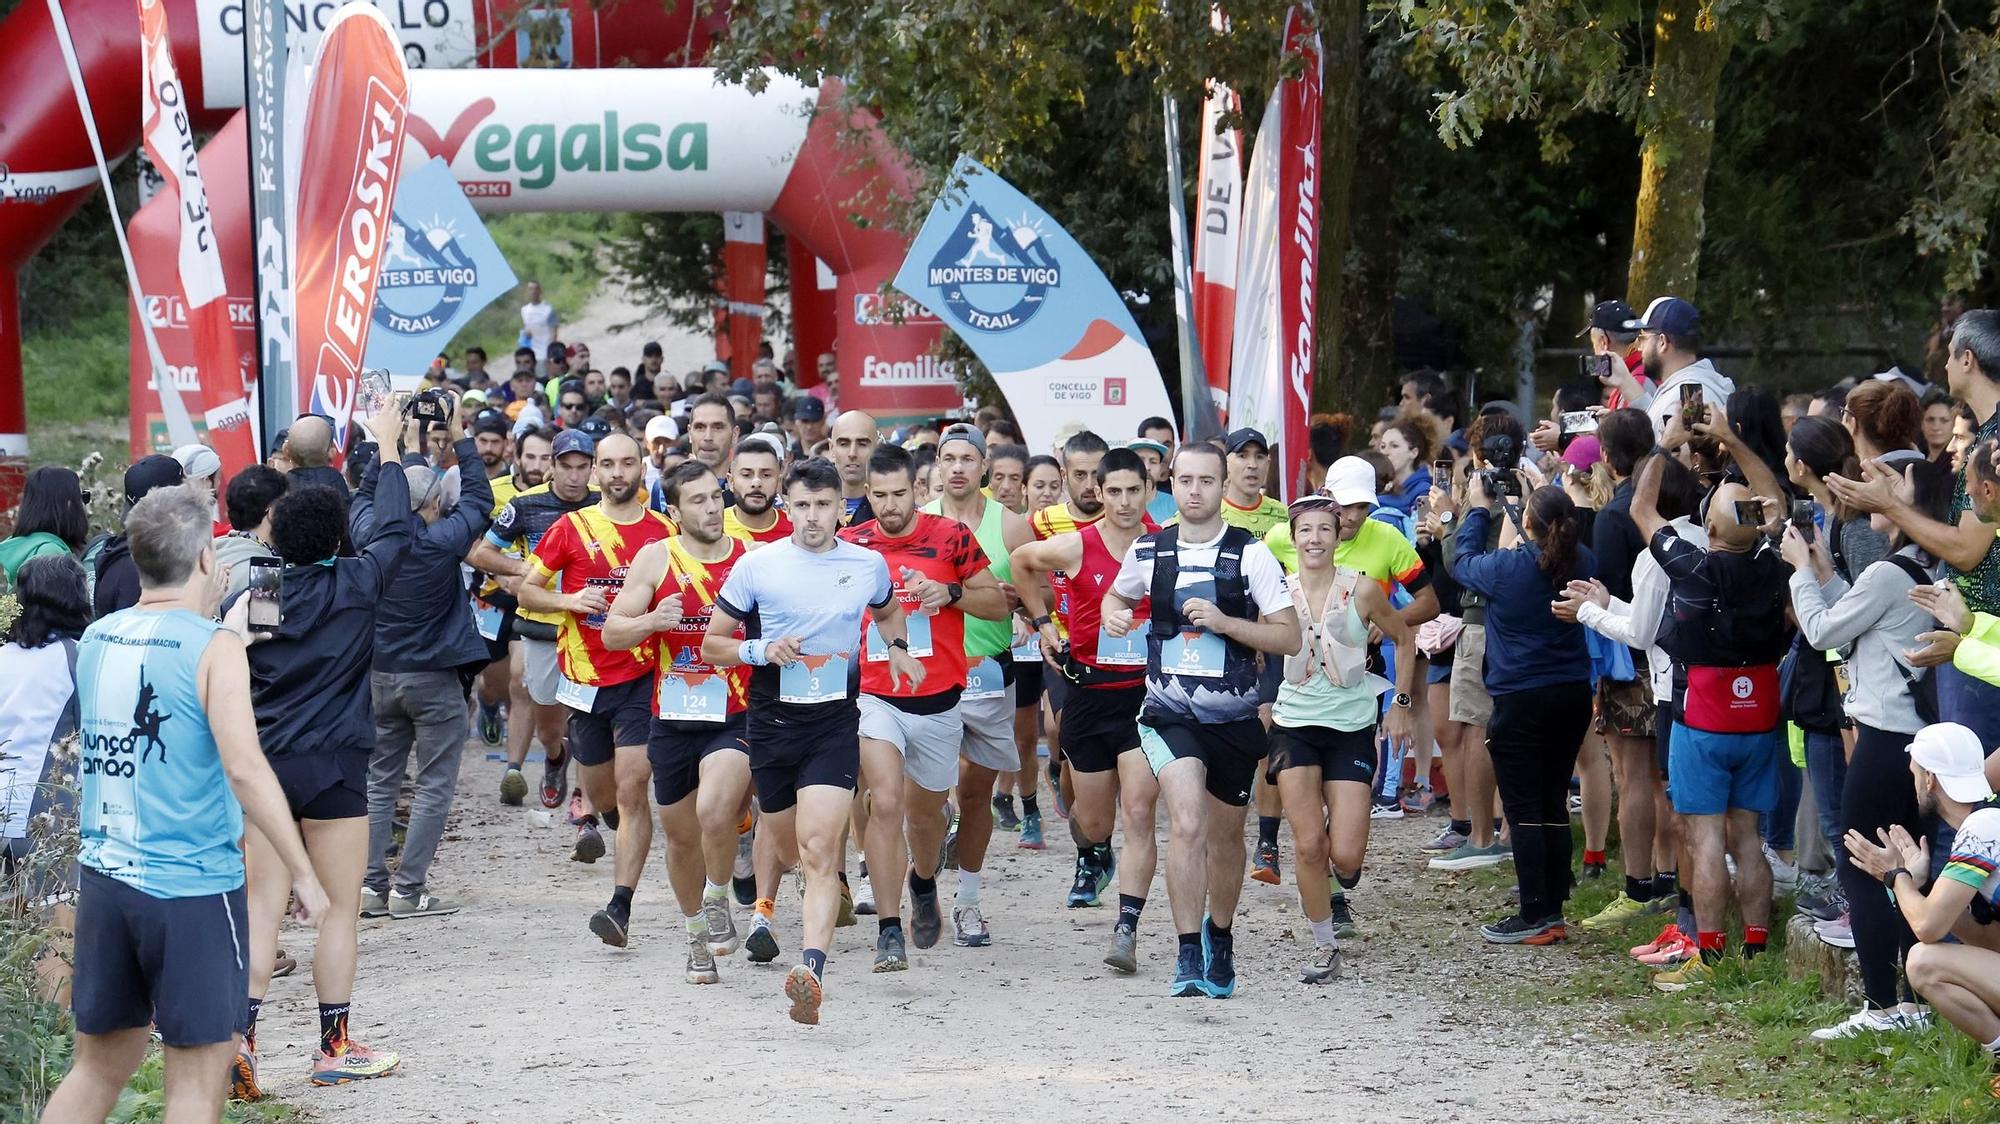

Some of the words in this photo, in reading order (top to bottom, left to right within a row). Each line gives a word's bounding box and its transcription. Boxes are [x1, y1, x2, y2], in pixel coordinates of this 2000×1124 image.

[1206, 179, 1232, 235] DE
[335, 101, 397, 346] EROSKI
[413, 270, 434, 284] DE
[437, 268, 475, 285] VIGO
[930, 268, 993, 285] MONTES
[997, 268, 1017, 282] DE
[1021, 268, 1058, 285] VIGO
[389, 314, 440, 332] TRAIL
[968, 309, 1020, 329] TRAIL
[1049, 383, 1097, 391] CONCELLO
[1126, 640, 1132, 652] 1
[1183, 648, 1200, 662] 56
[810, 677, 820, 691] 3
[682, 695, 708, 708] 124
